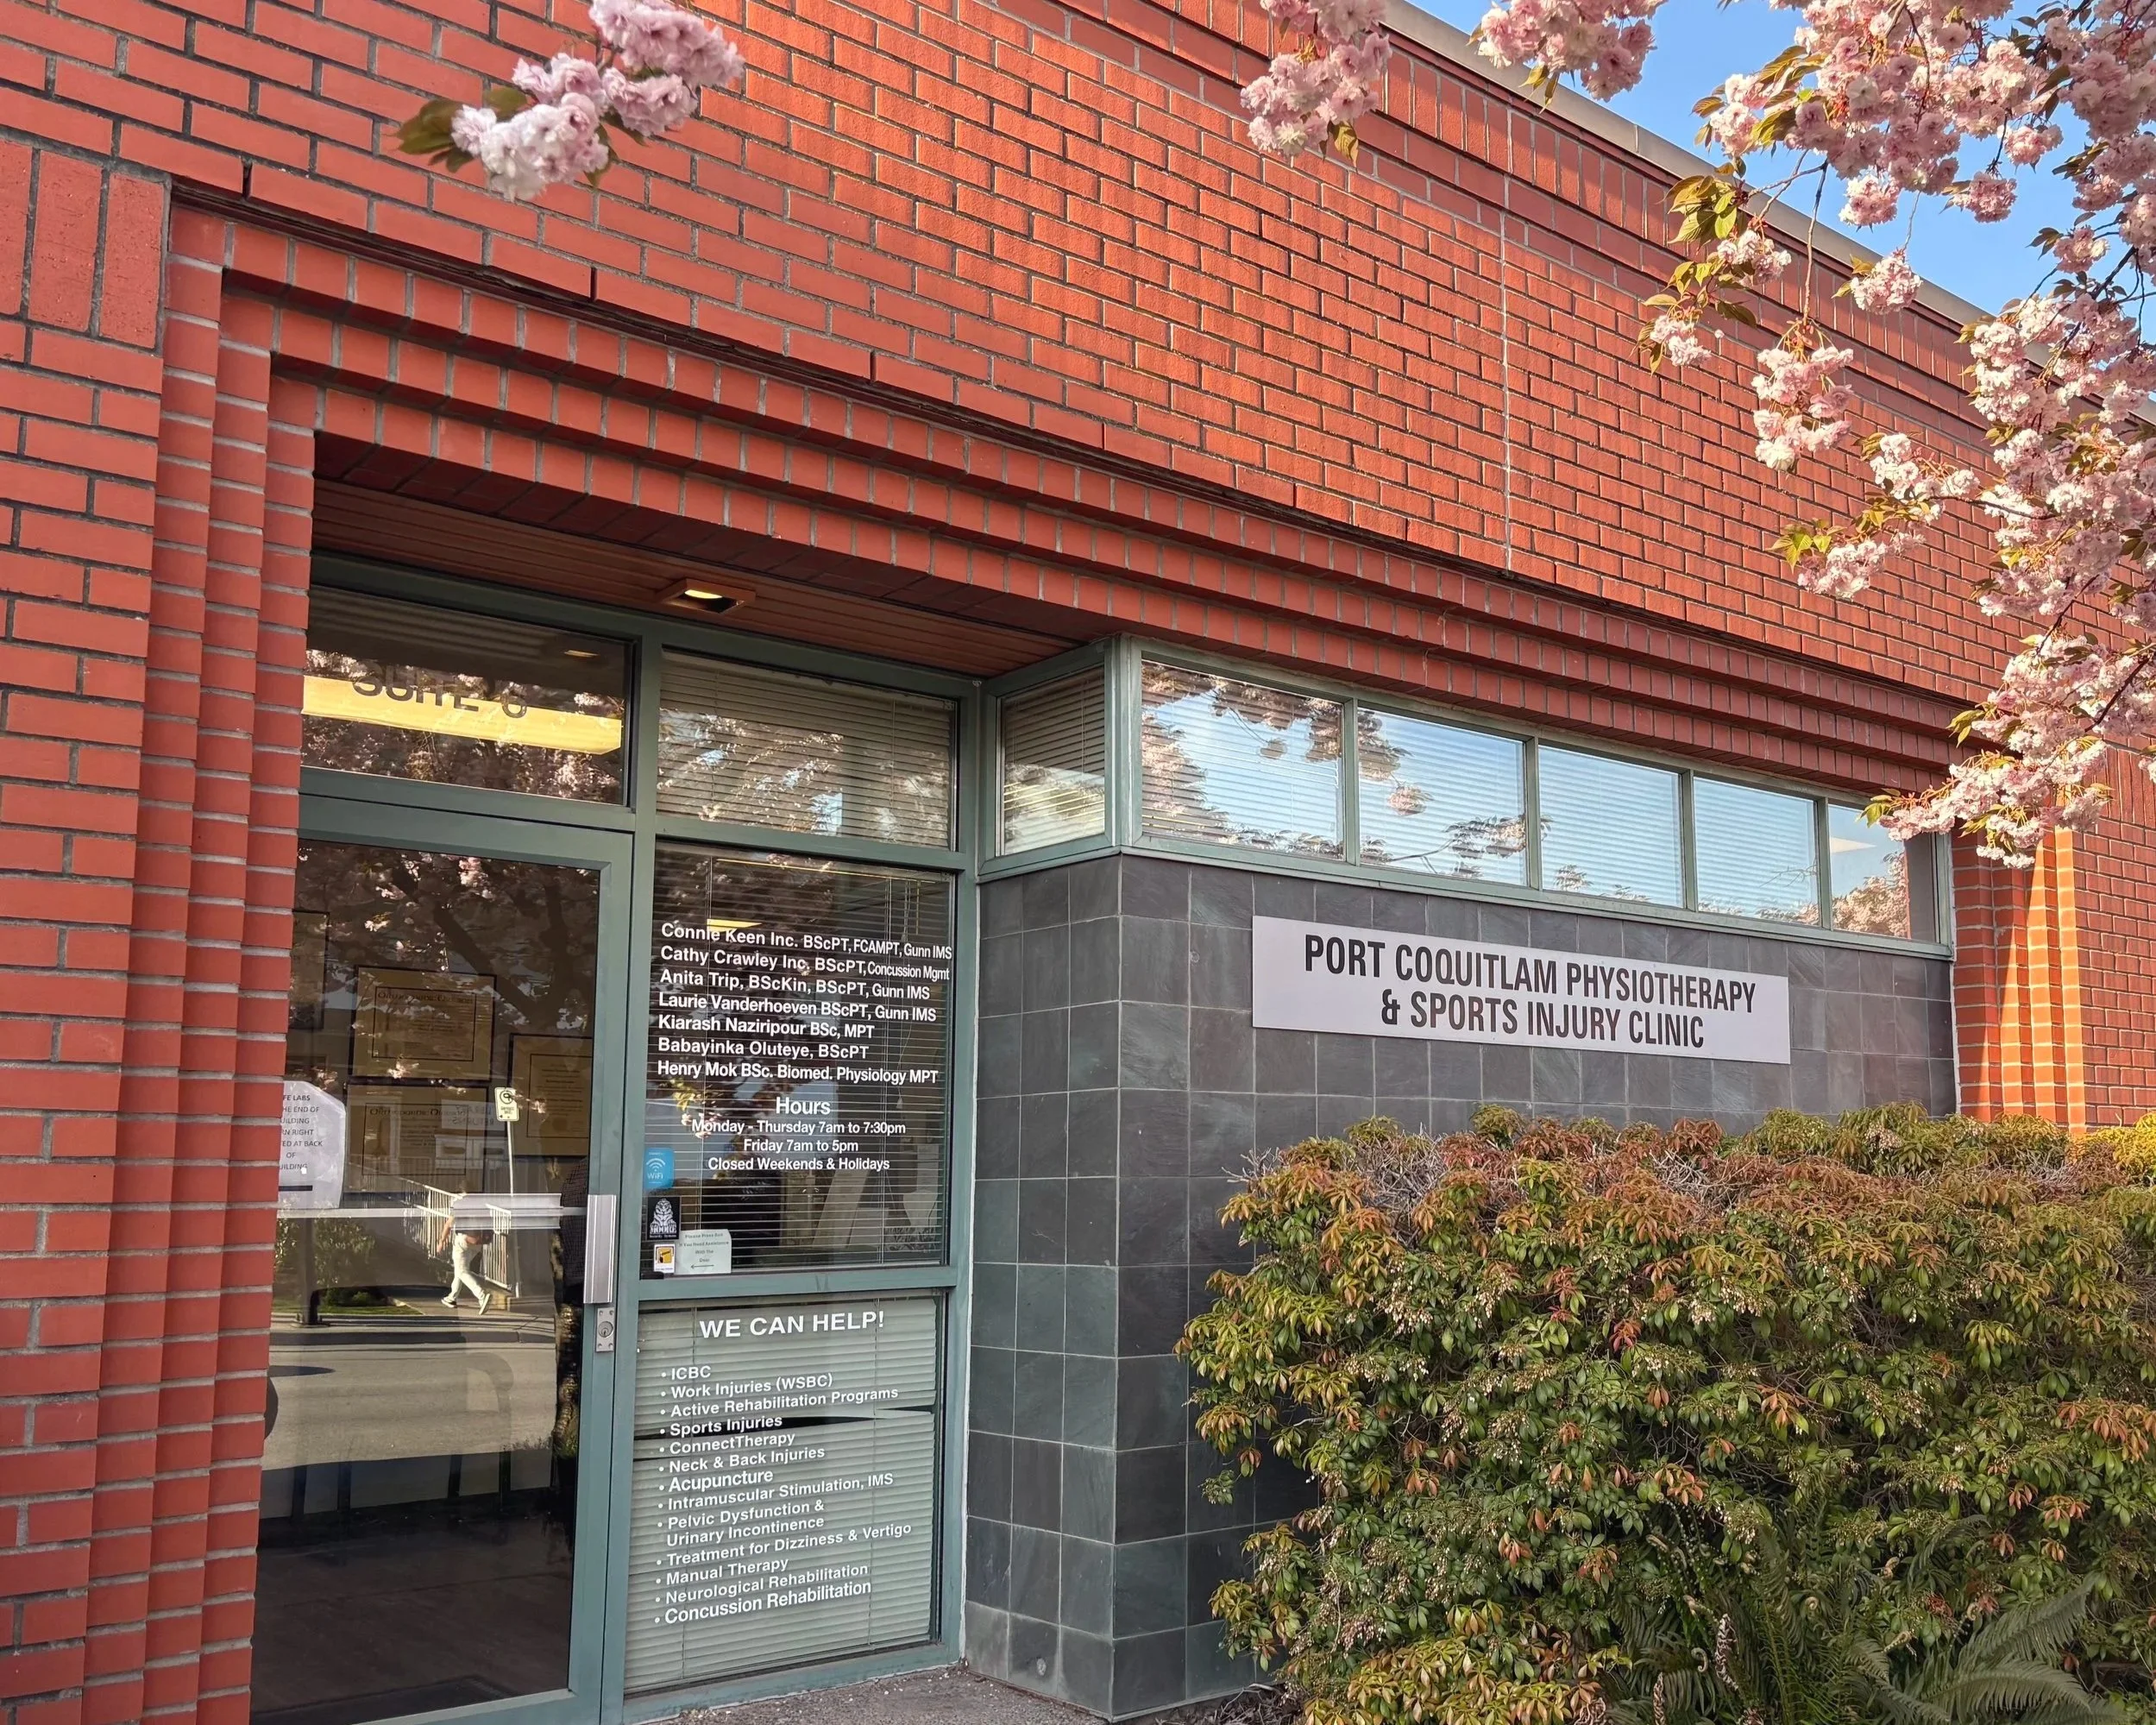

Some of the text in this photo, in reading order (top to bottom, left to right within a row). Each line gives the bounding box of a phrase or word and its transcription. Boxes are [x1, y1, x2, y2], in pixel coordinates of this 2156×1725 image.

[662, 923, 952, 960] Connie Keen Inc. BScPT, FCAMPT, Gunn IMS
[661, 945, 949, 981] Cathy Crawley Inc. BScPT, Concussion Mgmt
[1304, 934, 1757, 1014] PORT COQUITLAM PHYSIOTHERAPY
[660, 970, 930, 999] Anita Trip, BScKin, BScPT, Gunn IMS
[659, 992, 936, 1022] Laurie Vanderhoeven BScPT, Gunn IMS
[1381, 988, 1704, 1048] & SPORTS INJURY CLINIC
[658, 1015, 874, 1039] Kiarash Naziripour BSc, MPT
[658, 1038, 869, 1061] Babayinka Oluteye, BScPT
[658, 1061, 938, 1086] Henry Mok BSc. Biomed. Physiology MPT
[776, 1097, 830, 1115] Hours
[692, 1118, 745, 1135] Monday
[757, 1120, 817, 1136] Thursday
[820, 1122, 845, 1133] 7am
[848, 1123, 860, 1134] to
[864, 1123, 906, 1136] 7:30pm
[744, 1138, 858, 1155] Friday 7am to 5pm
[708, 1157, 889, 1172] Closed Weekends & Holidays
[700, 1312, 884, 1338] WE CAN HELP!
[671, 1366, 711, 1380] ICBC
[671, 1373, 833, 1399] Work Injuries (WSBC)
[671, 1387, 898, 1418] Active Rehabilitation Programs
[670, 1415, 783, 1439] Sports Injuries
[670, 1432, 795, 1455] ConnectTherapy
[669, 1447, 825, 1473] Neck & Back Injuries
[669, 1470, 773, 1494] Acupuncture
[669, 1473, 893, 1510] Intramuscular Stimulation, IMS
[669, 1500, 825, 1530] Pelvic Dysfunction &
[667, 1517, 824, 1547] Urinary Incontinence
[667, 1523, 912, 1566] Treatment for Dizziness & Vertigo
[666, 1564, 869, 1605] Neurological Rehabilitation
[667, 1558, 789, 1585] Manual Therapy
[664, 1582, 871, 1625] Concussion Rehabilitation
